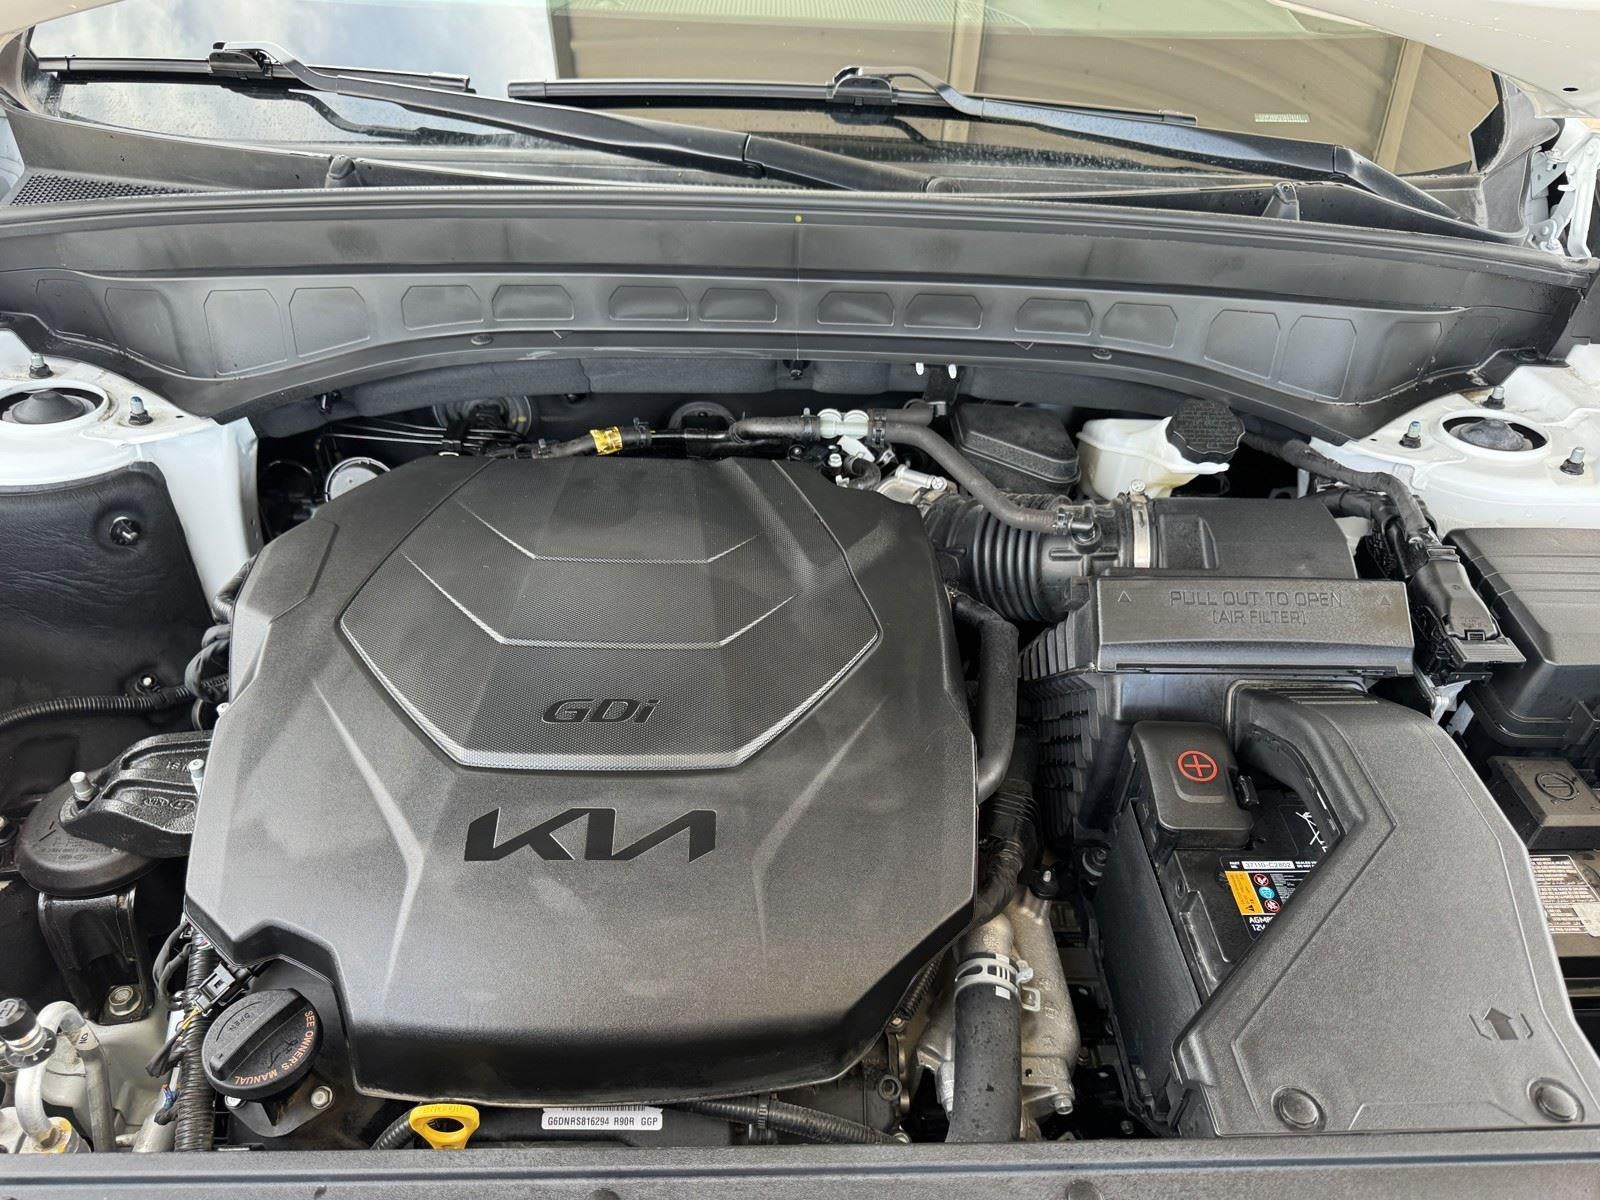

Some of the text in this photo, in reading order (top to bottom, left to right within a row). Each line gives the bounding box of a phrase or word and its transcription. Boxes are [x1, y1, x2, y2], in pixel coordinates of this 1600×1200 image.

[1170, 590, 1343, 608] PULL OUT TO OPEN
[541, 698, 660, 724] GDi
[464, 806, 717, 862] KIA
[234, 1010, 315, 1085] SEE OWNER'S MANUAL
[640, 1116, 658, 1126] GGP
